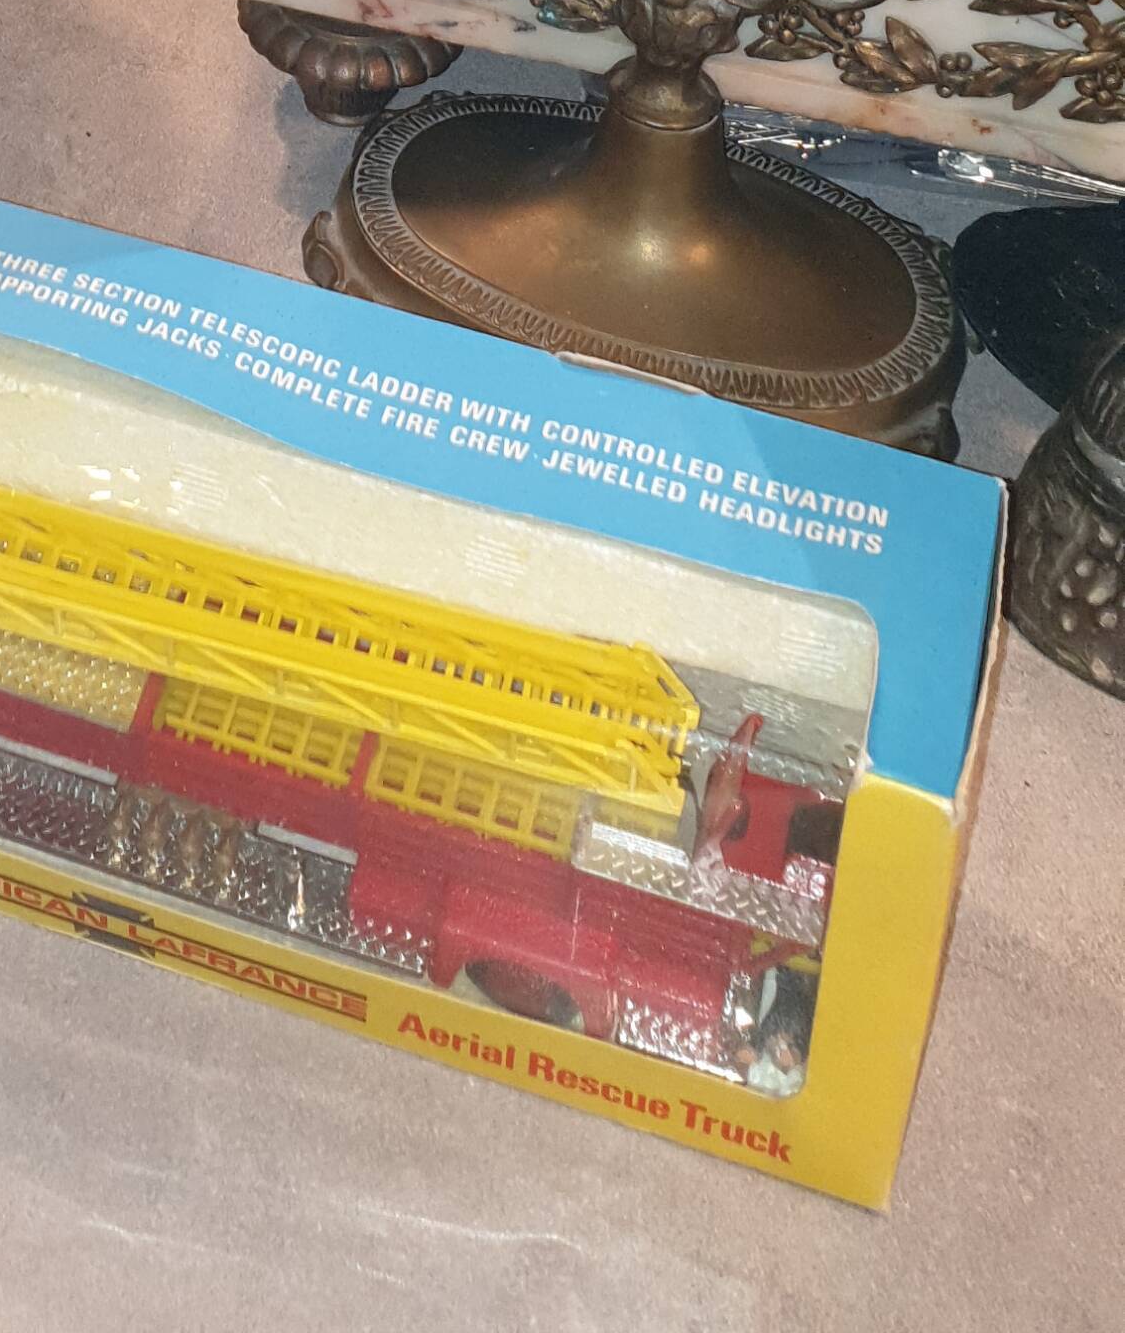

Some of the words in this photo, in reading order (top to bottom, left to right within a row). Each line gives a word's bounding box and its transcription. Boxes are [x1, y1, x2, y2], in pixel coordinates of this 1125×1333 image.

[73, 273, 182, 318] SECTION
[189, 306, 342, 379] TELESCOPIC
[347, 365, 453, 413] LADDER
[460, 397, 531, 433] WITH
[541, 419, 724, 484] CONTROLLED
[732, 470, 889, 528] ELEVATION
[136, 317, 222, 359] JACKS
[234, 351, 373, 419] COMPLETE
[380, 404, 441, 439] FIRE
[449, 425, 531, 461] CREW
[542, 449, 688, 503] JEWELLED
[698, 489, 884, 555] HEADLIGHTS
[397, 1012, 517, 1070] Aerial
[527, 1051, 671, 1121] Rescue
[680, 1099, 792, 1165] Truck
